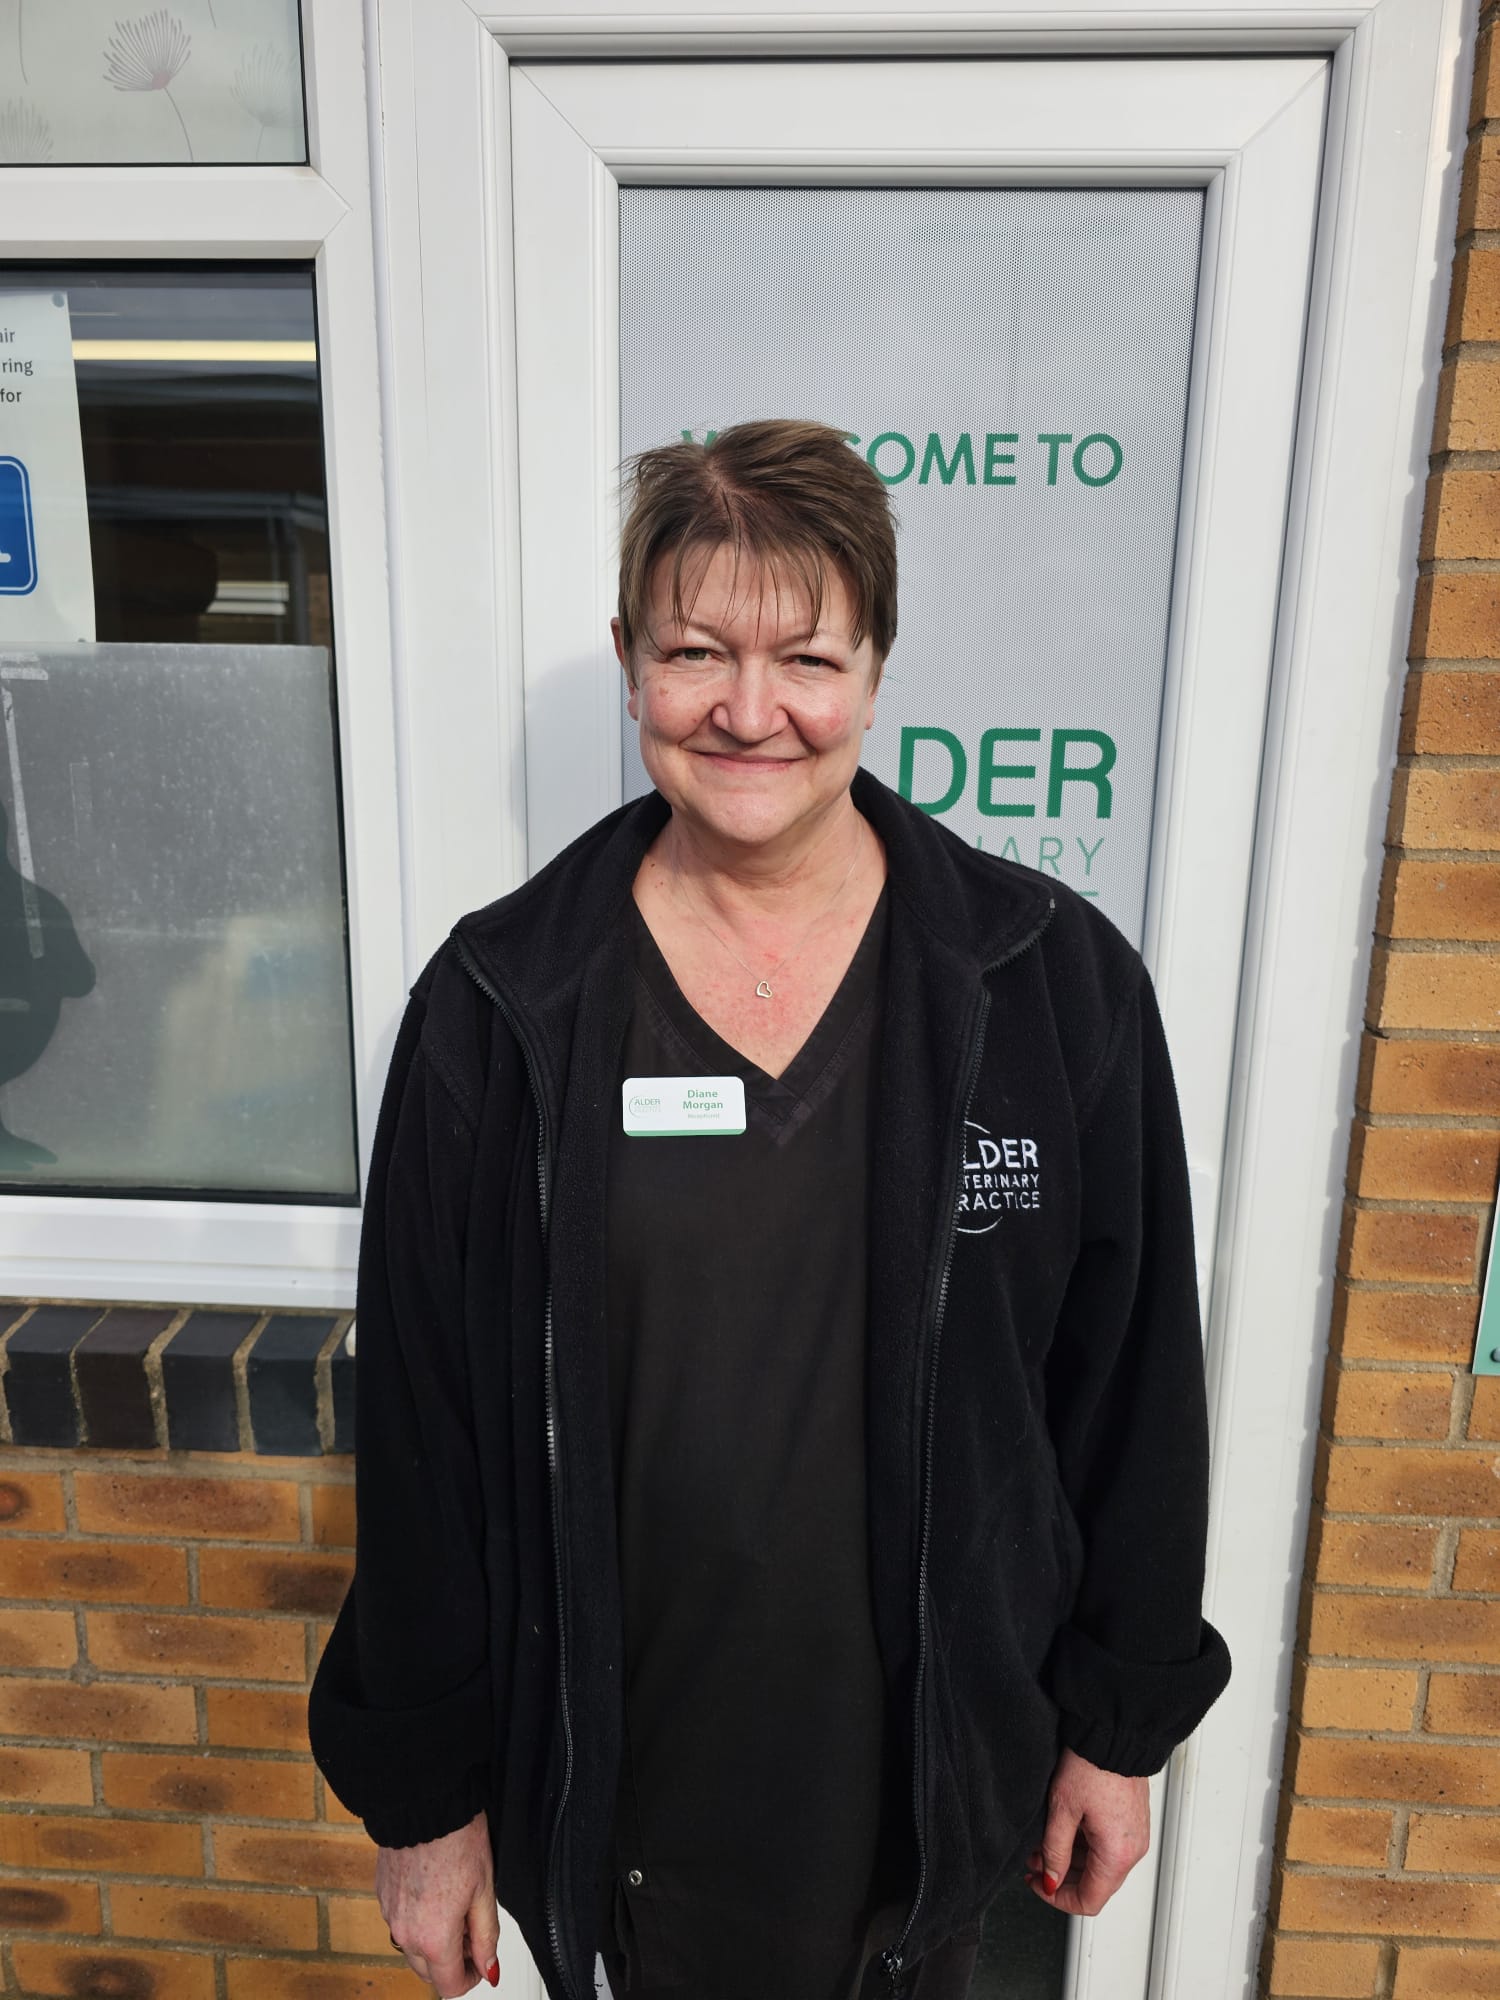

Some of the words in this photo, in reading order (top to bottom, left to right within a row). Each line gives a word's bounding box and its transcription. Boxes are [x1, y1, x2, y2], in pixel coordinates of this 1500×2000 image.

[2, 358, 33, 376] ring
[0, 388, 22, 403] for
[1037, 432, 1123, 487] TO
[898, 726, 1117, 819] DER
[687, 1089, 718, 1098] Diane
[682, 1100, 724, 1111] Morgan
